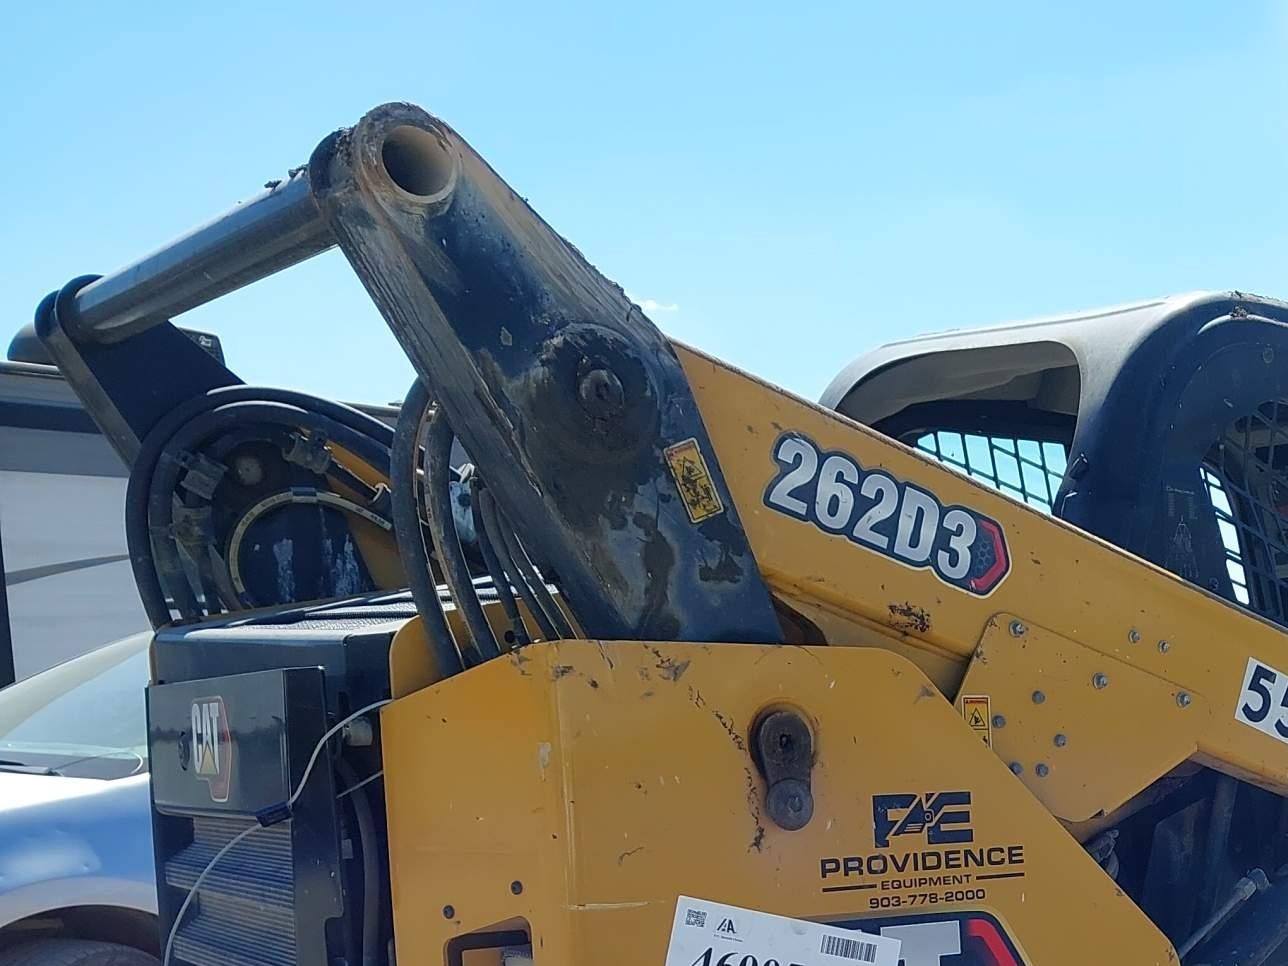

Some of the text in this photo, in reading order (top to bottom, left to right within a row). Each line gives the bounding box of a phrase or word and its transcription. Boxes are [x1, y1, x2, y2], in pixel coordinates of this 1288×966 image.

[769, 437, 977, 580] 262D3
[192, 702, 220, 776] CAT
[820, 845, 1025, 879] PROVIDENCE
[869, 888, 986, 910] 903-778-2000
[881, 874, 972, 891] EQUIPMENT
